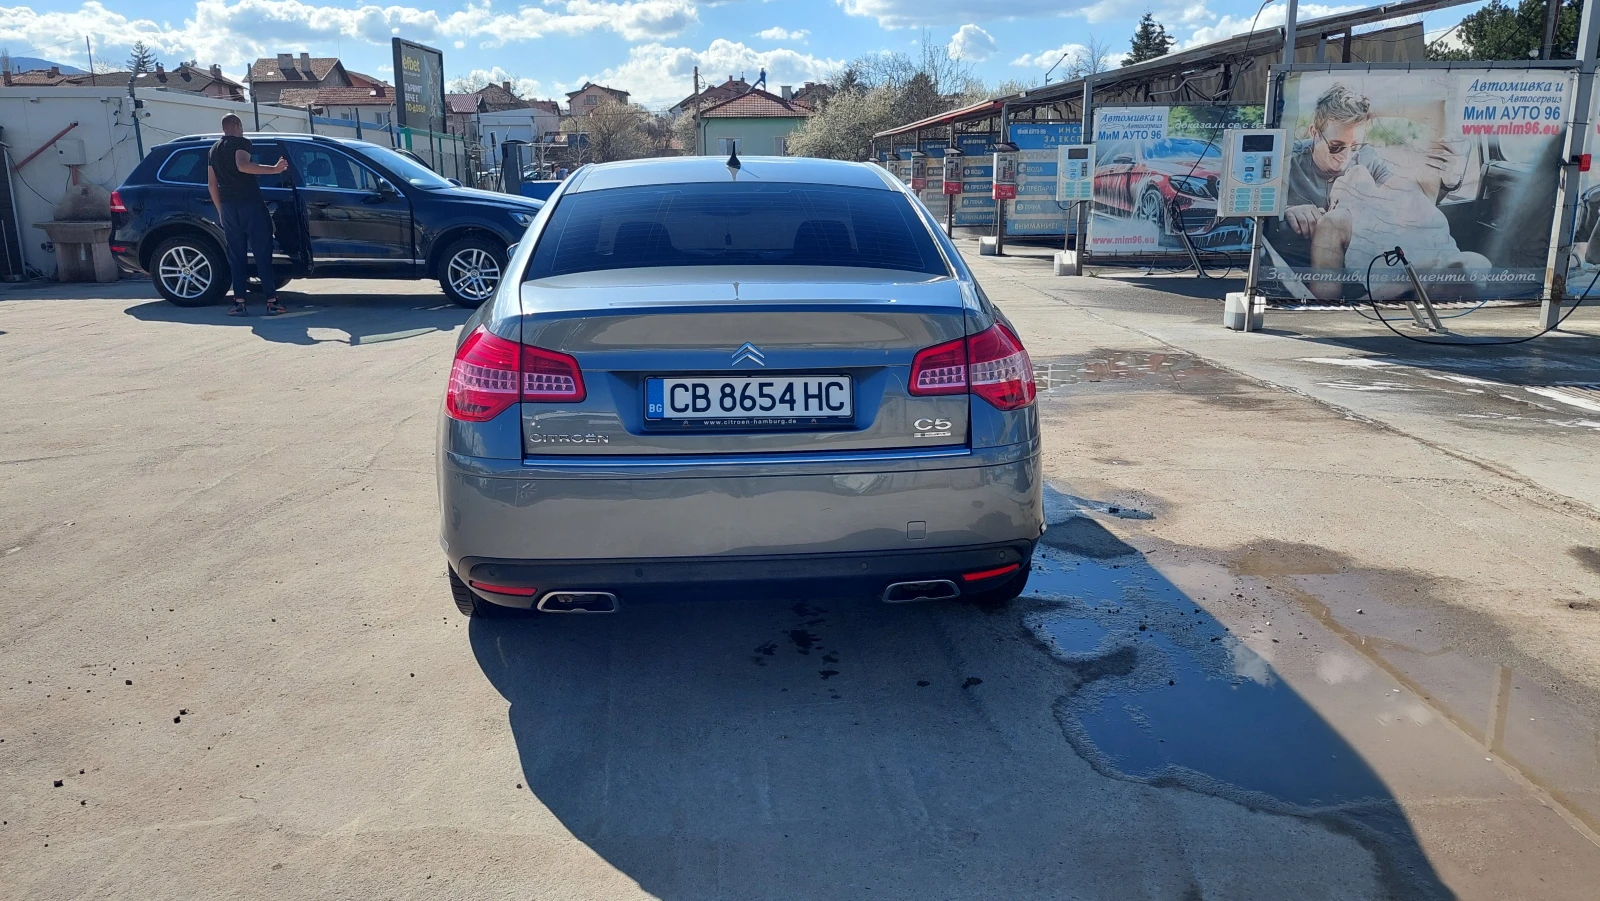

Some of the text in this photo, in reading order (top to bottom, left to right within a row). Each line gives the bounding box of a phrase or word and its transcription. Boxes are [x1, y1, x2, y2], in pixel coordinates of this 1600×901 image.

[1467, 79, 1564, 92] Автомивка и
[1507, 94, 1562, 106] Автосервиз
[1100, 113, 1155, 122] Автомивка
[1463, 106, 1560, 120] МиМ АУТО 96
[1098, 130, 1162, 140] МиМ АУТО 96
[1267, 267, 1286, 280] За
[1469, 270, 1477, 282] в
[1480, 270, 1536, 282] живота
[670, 381, 845, 413] CB 8654 HC
[649, 404, 662, 413] BG
[703, 418, 797, 426] www.citroen-hamburg.de
[913, 418, 952, 430] C5
[529, 433, 609, 443] CITROËN
